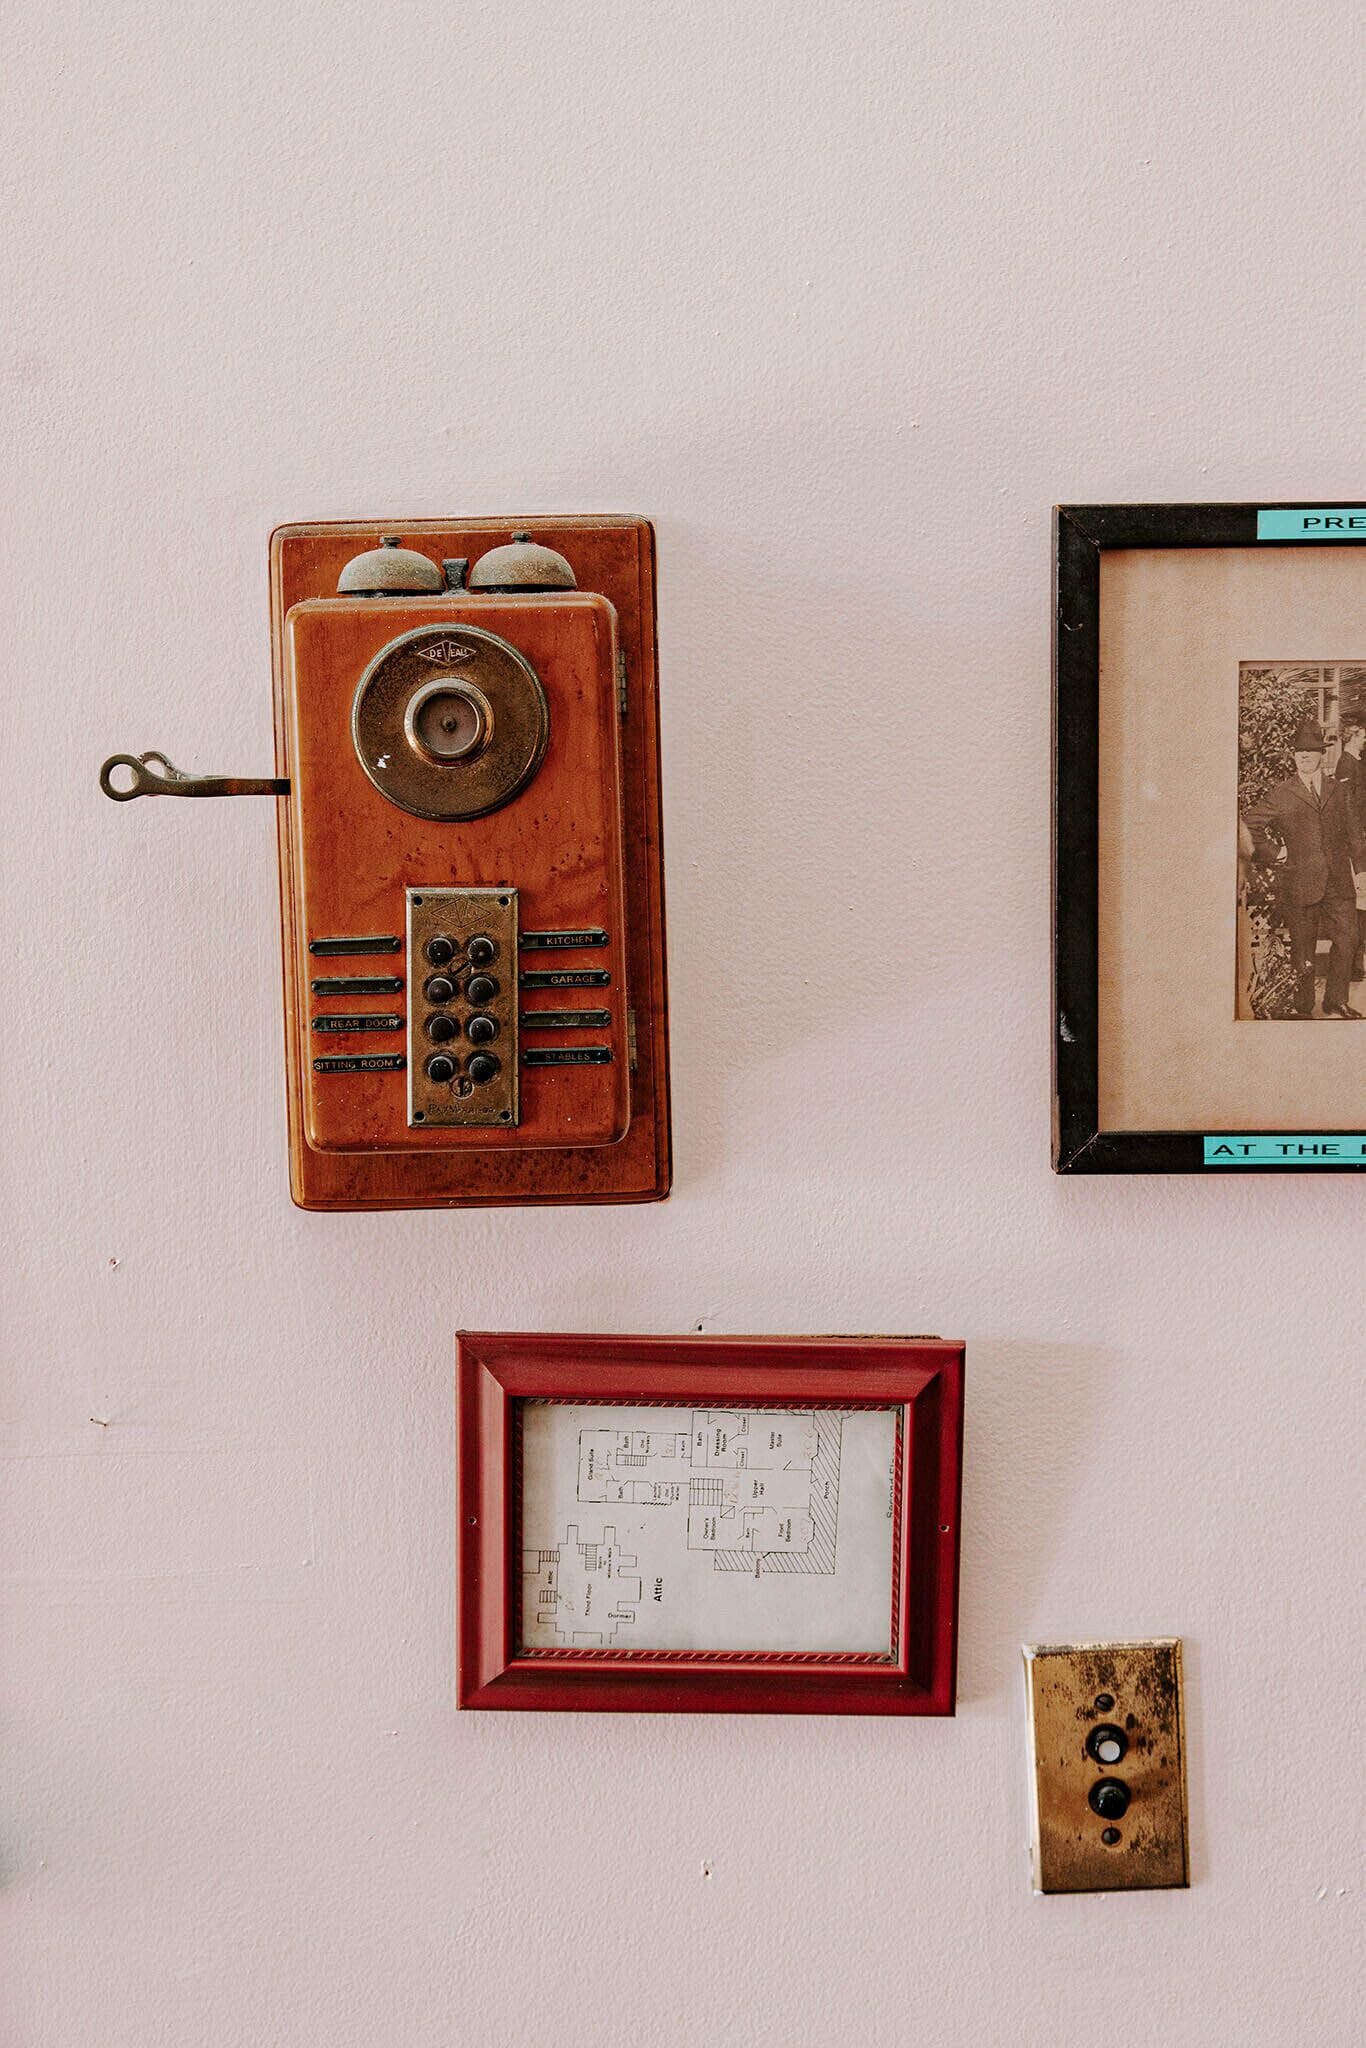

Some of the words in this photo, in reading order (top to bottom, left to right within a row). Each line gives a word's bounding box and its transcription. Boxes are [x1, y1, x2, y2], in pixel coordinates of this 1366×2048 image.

[1303, 517, 1366, 529] PRE
[546, 935, 593, 945] KITCHEN
[550, 974, 597, 985] GARAGE
[330, 1020, 360, 1029] REAR
[365, 1019, 396, 1028] DOOR
[544, 1052, 591, 1061] STABLES
[314, 1062, 356, 1071] SITTING
[361, 1059, 394, 1069] ROOM
[1212, 1144, 1257, 1156] AT
[1275, 1143, 1340, 1156] THE
[714, 1428, 722, 1456] Dressing
[653, 1577, 663, 1602] Attic
